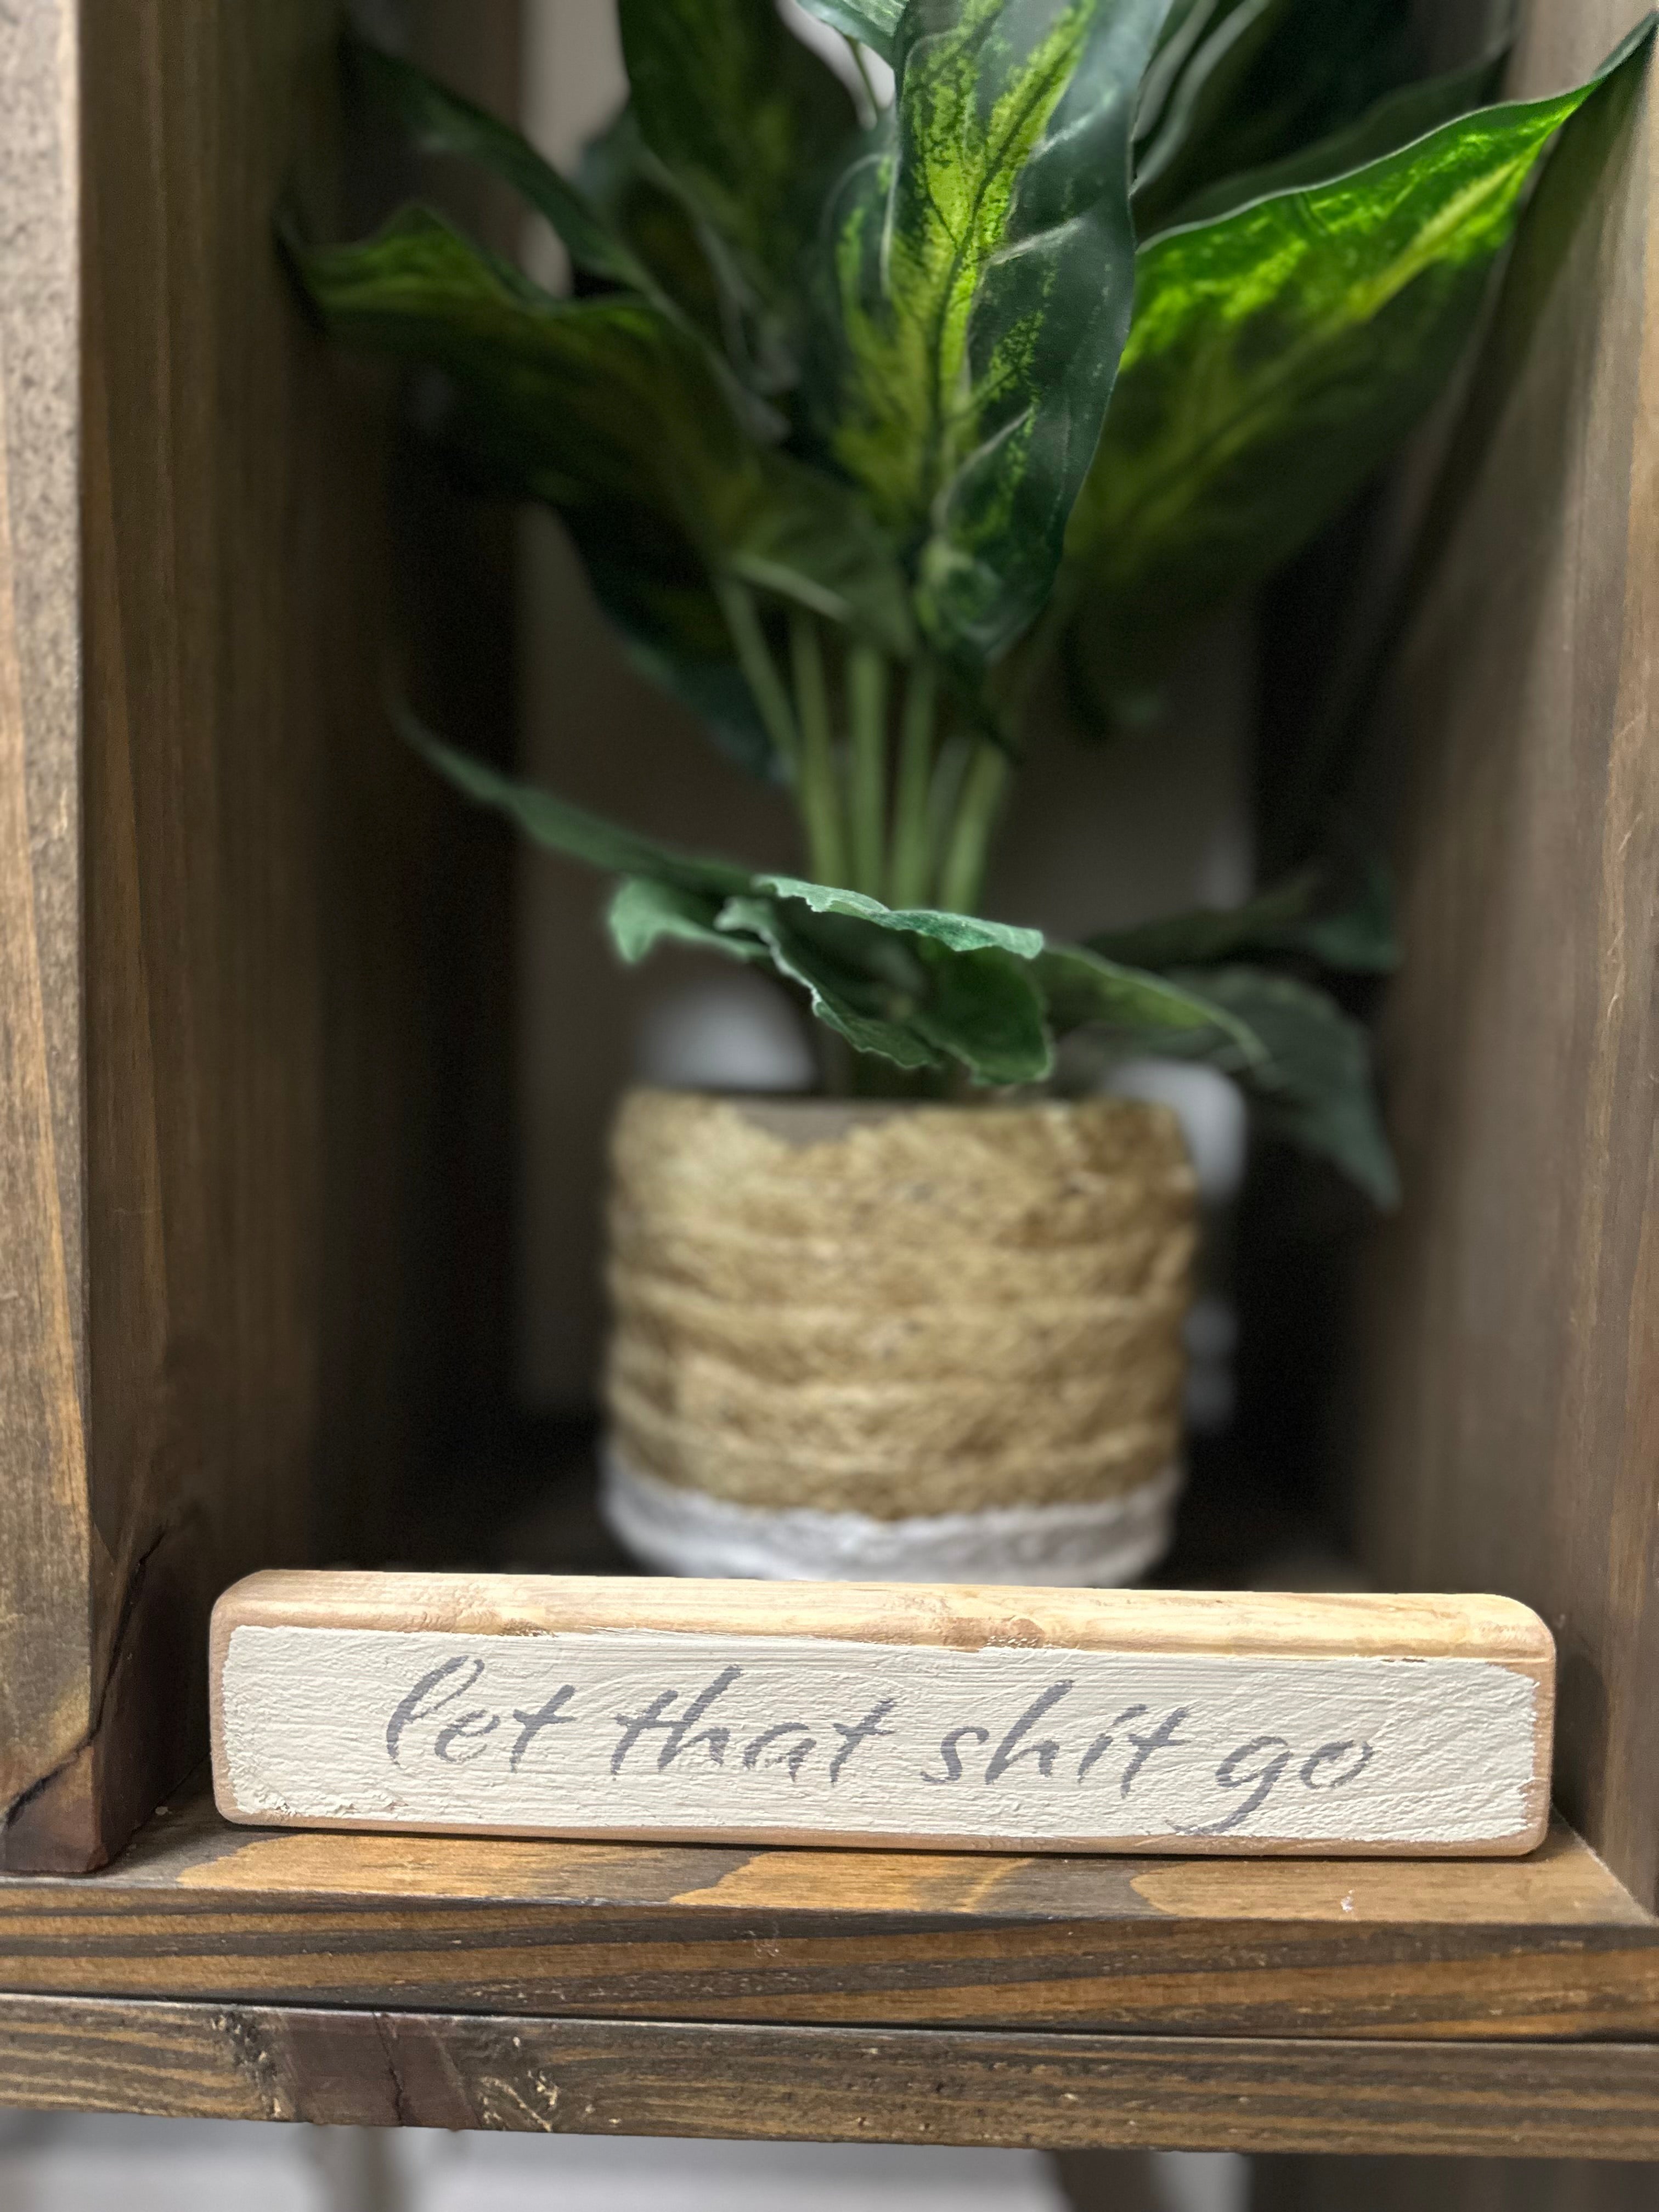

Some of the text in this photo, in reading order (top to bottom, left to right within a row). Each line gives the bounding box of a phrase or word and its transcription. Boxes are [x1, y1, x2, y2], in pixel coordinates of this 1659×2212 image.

[386, 1655, 1375, 1836] let that shit go
